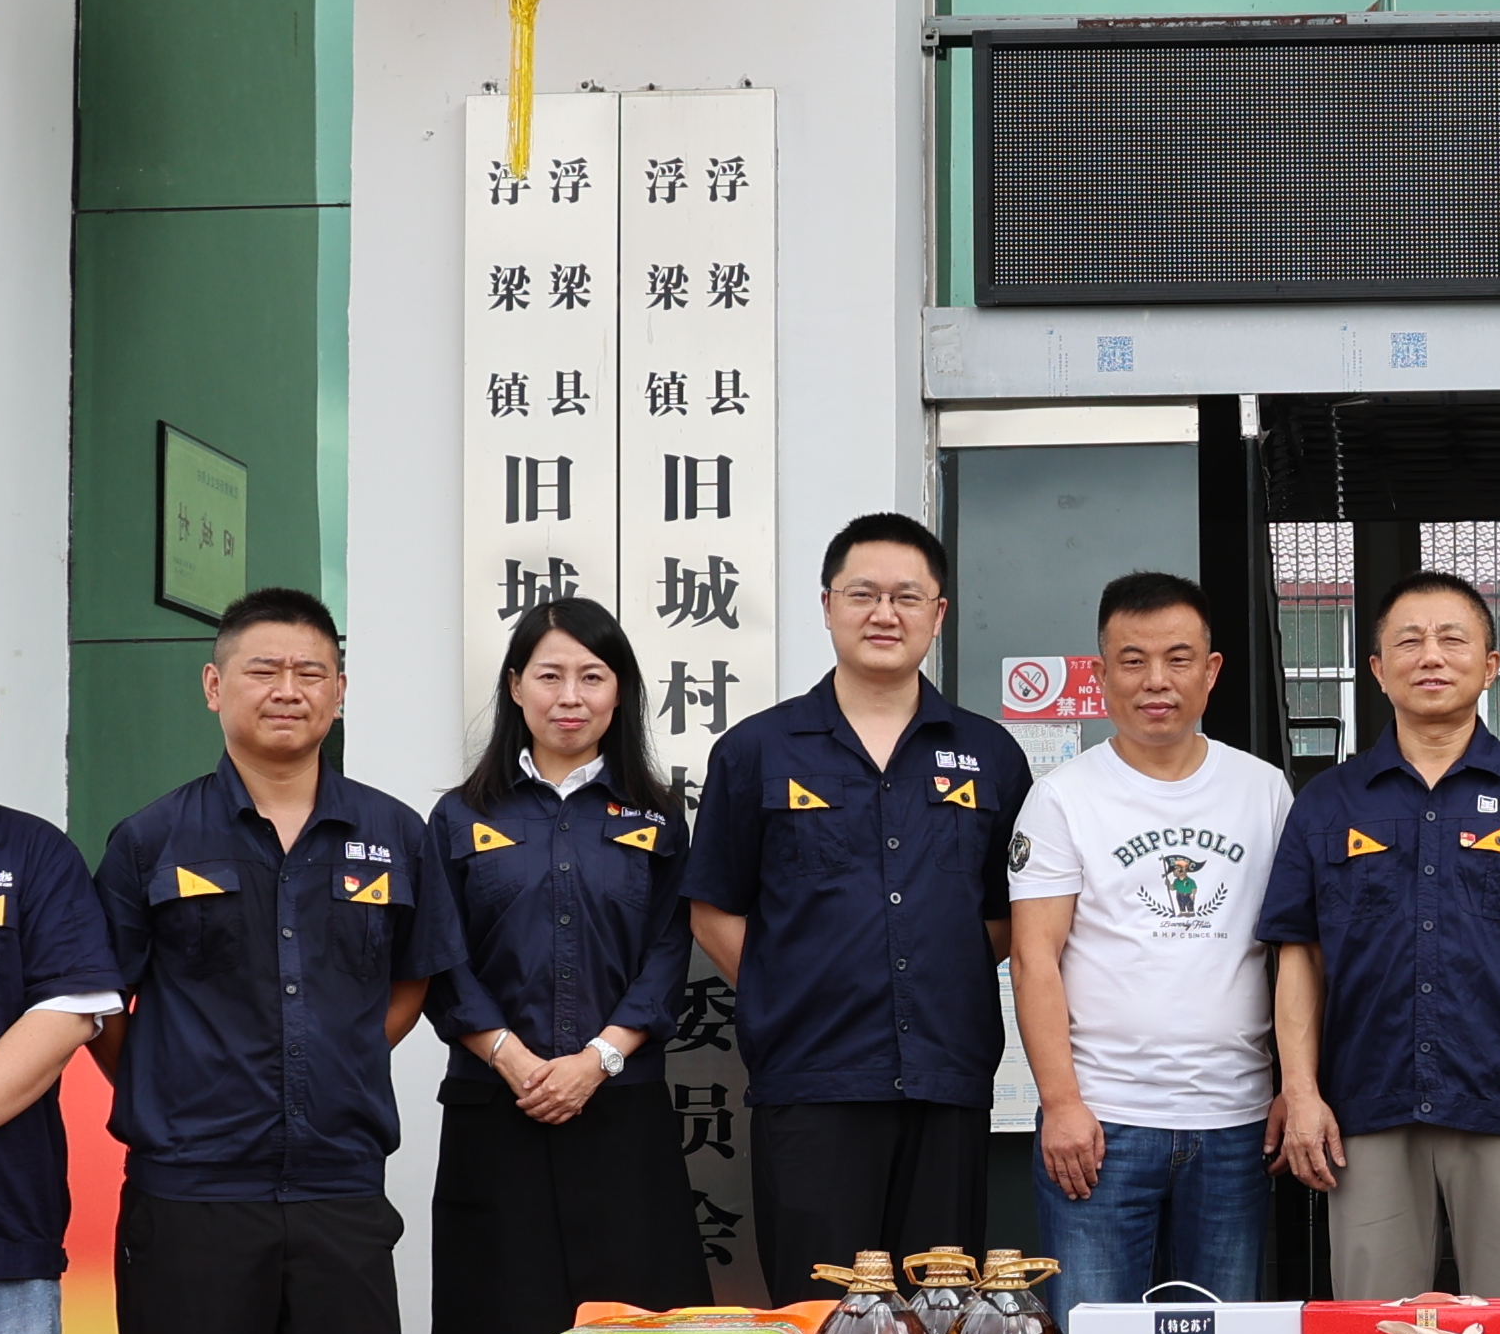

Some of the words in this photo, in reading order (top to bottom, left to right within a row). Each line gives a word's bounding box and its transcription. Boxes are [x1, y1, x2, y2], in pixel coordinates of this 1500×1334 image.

[486, 160, 531, 419] 浮梁镇
[548, 157, 592, 417] 浮梁县
[645, 158, 689, 417] 浮梁镇
[706, 156, 750, 415] 浮梁县
[1056, 697, 1107, 716] 禁止
[1078, 685, 1093, 695] NO
[1111, 827, 1246, 869] BHPCPOLO
[1167, 1319, 1202, 1334] 特仑苏
